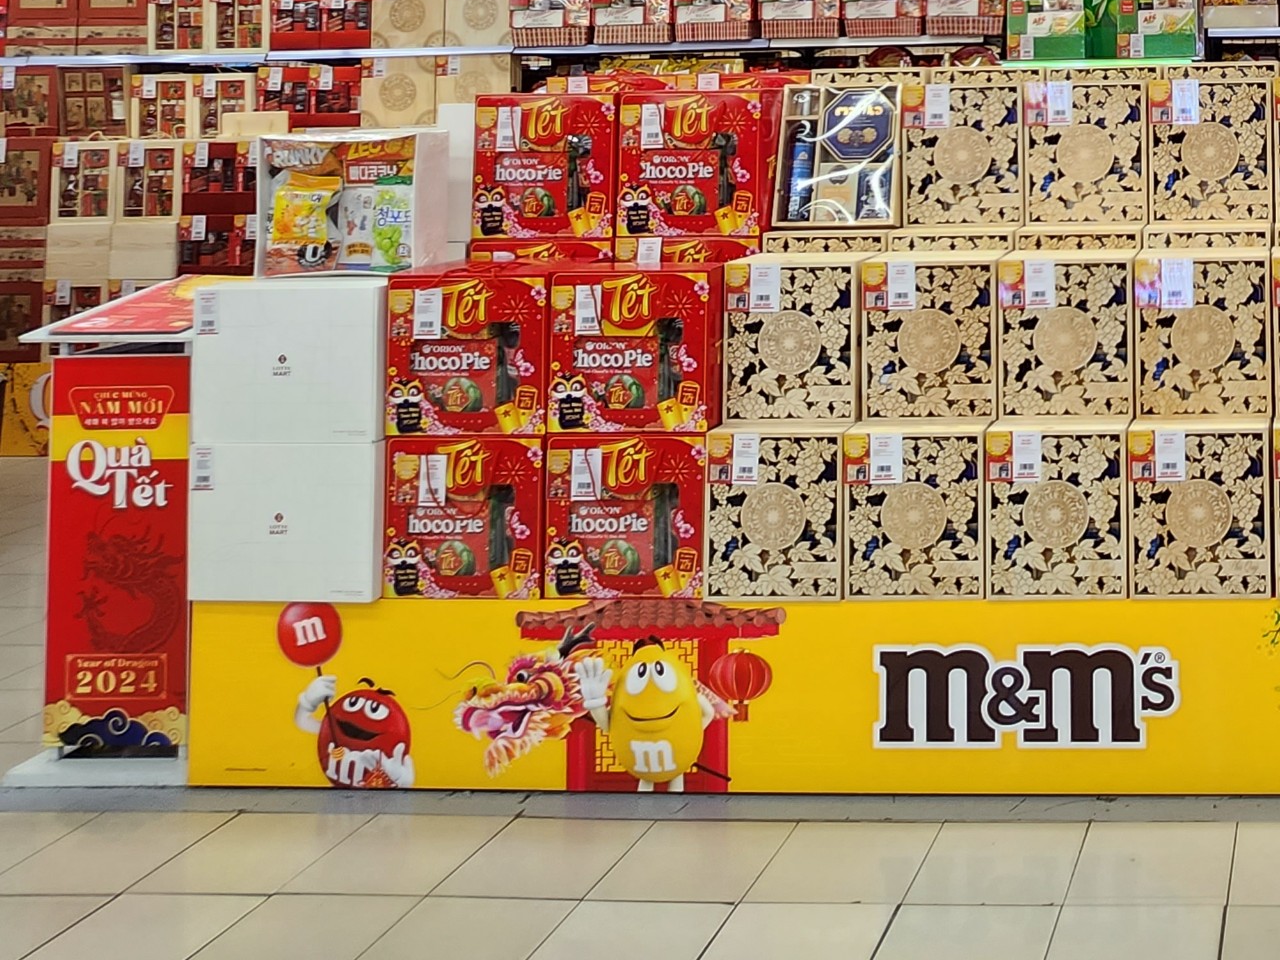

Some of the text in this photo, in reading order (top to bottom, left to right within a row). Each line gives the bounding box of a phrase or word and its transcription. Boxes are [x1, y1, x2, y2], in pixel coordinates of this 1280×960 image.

[521, 96, 571, 139] Tết
[441, 279, 494, 328] Tết
[431, 345, 465, 353] ORION
[80, 397, 163, 414] NĂM MỚI
[66, 437, 151, 495] Quà
[104, 470, 174, 508] Tết
[293, 616, 326, 647] m
[77, 658, 158, 668] Year of Dragon
[76, 670, 157, 693] 2024
[629, 740, 677, 773] m
